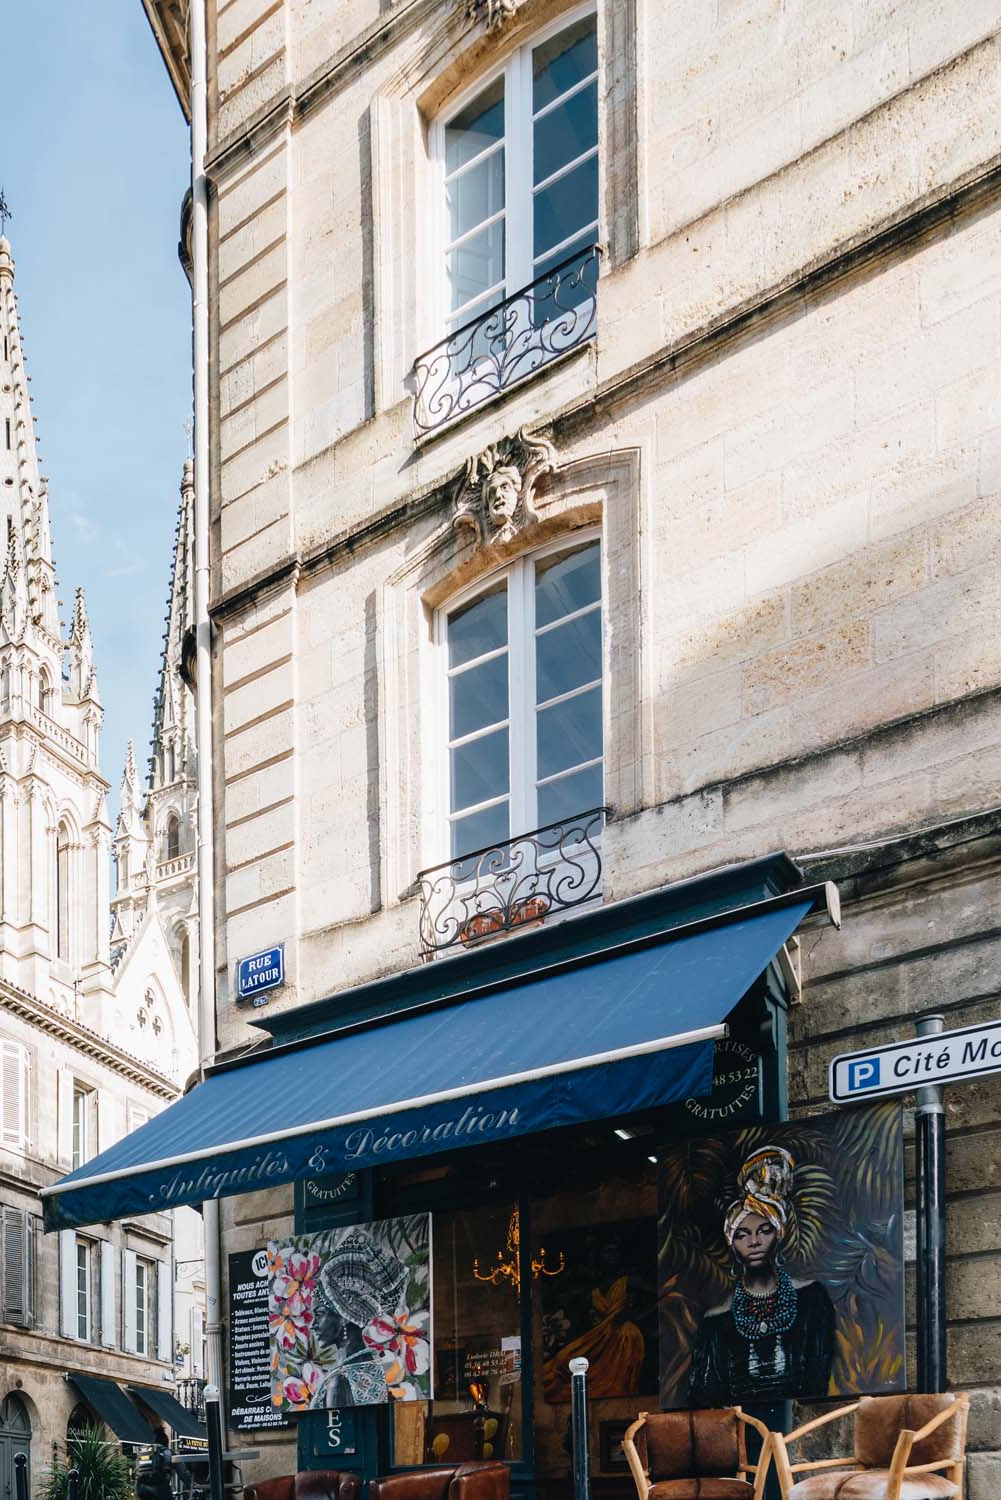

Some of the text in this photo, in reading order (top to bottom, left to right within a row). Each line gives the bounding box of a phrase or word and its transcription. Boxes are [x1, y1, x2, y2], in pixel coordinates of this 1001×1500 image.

[249, 955, 272, 972] RUE
[242, 968, 279, 990] LATOUR
[894, 1047, 950, 1078] Cité
[728, 1071, 742, 1083] 53
[744, 1066, 759, 1079] 22
[685, 1083, 756, 1119] GRATUITES
[148, 1105, 520, 1198] Antiquités & Décoration
[233, 1290, 256, 1300] TOUTES
[237, 1282, 255, 1291] NOUS
[231, 1406, 264, 1416] DÉBARRAS
[244, 1413, 282, 1423] DE MAISONS
